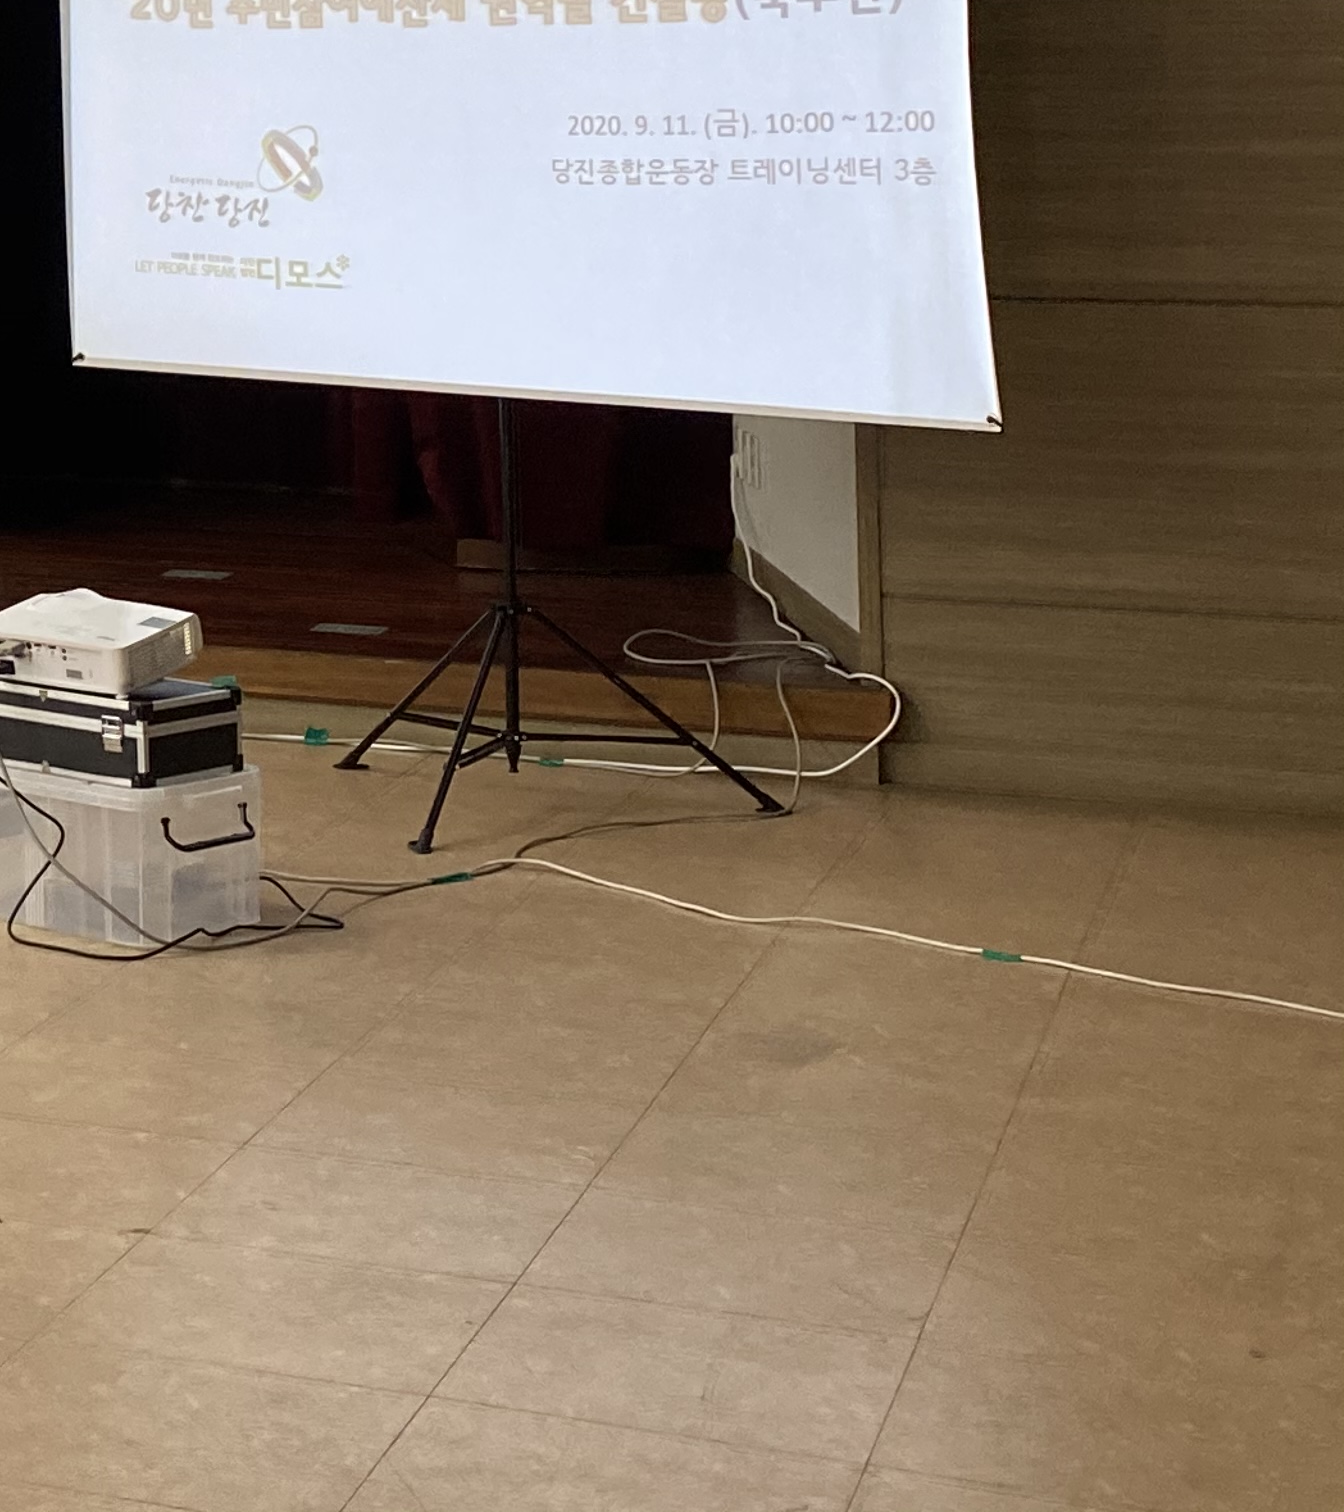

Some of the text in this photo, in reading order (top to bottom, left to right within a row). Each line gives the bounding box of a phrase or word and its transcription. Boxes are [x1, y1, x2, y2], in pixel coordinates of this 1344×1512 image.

[566, 113, 629, 138] 2020.
[765, 110, 835, 136] 10:00
[863, 109, 936, 134] 12:00
[551, 155, 938, 188] 당진종합운동장 트레이닝센터 3층
[215, 194, 270, 227] 당진
[134, 260, 154, 273] LET
[157, 261, 197, 276] PEOPLE
[201, 265, 237, 278] SPEAK
[256, 256, 343, 290] 디모스
